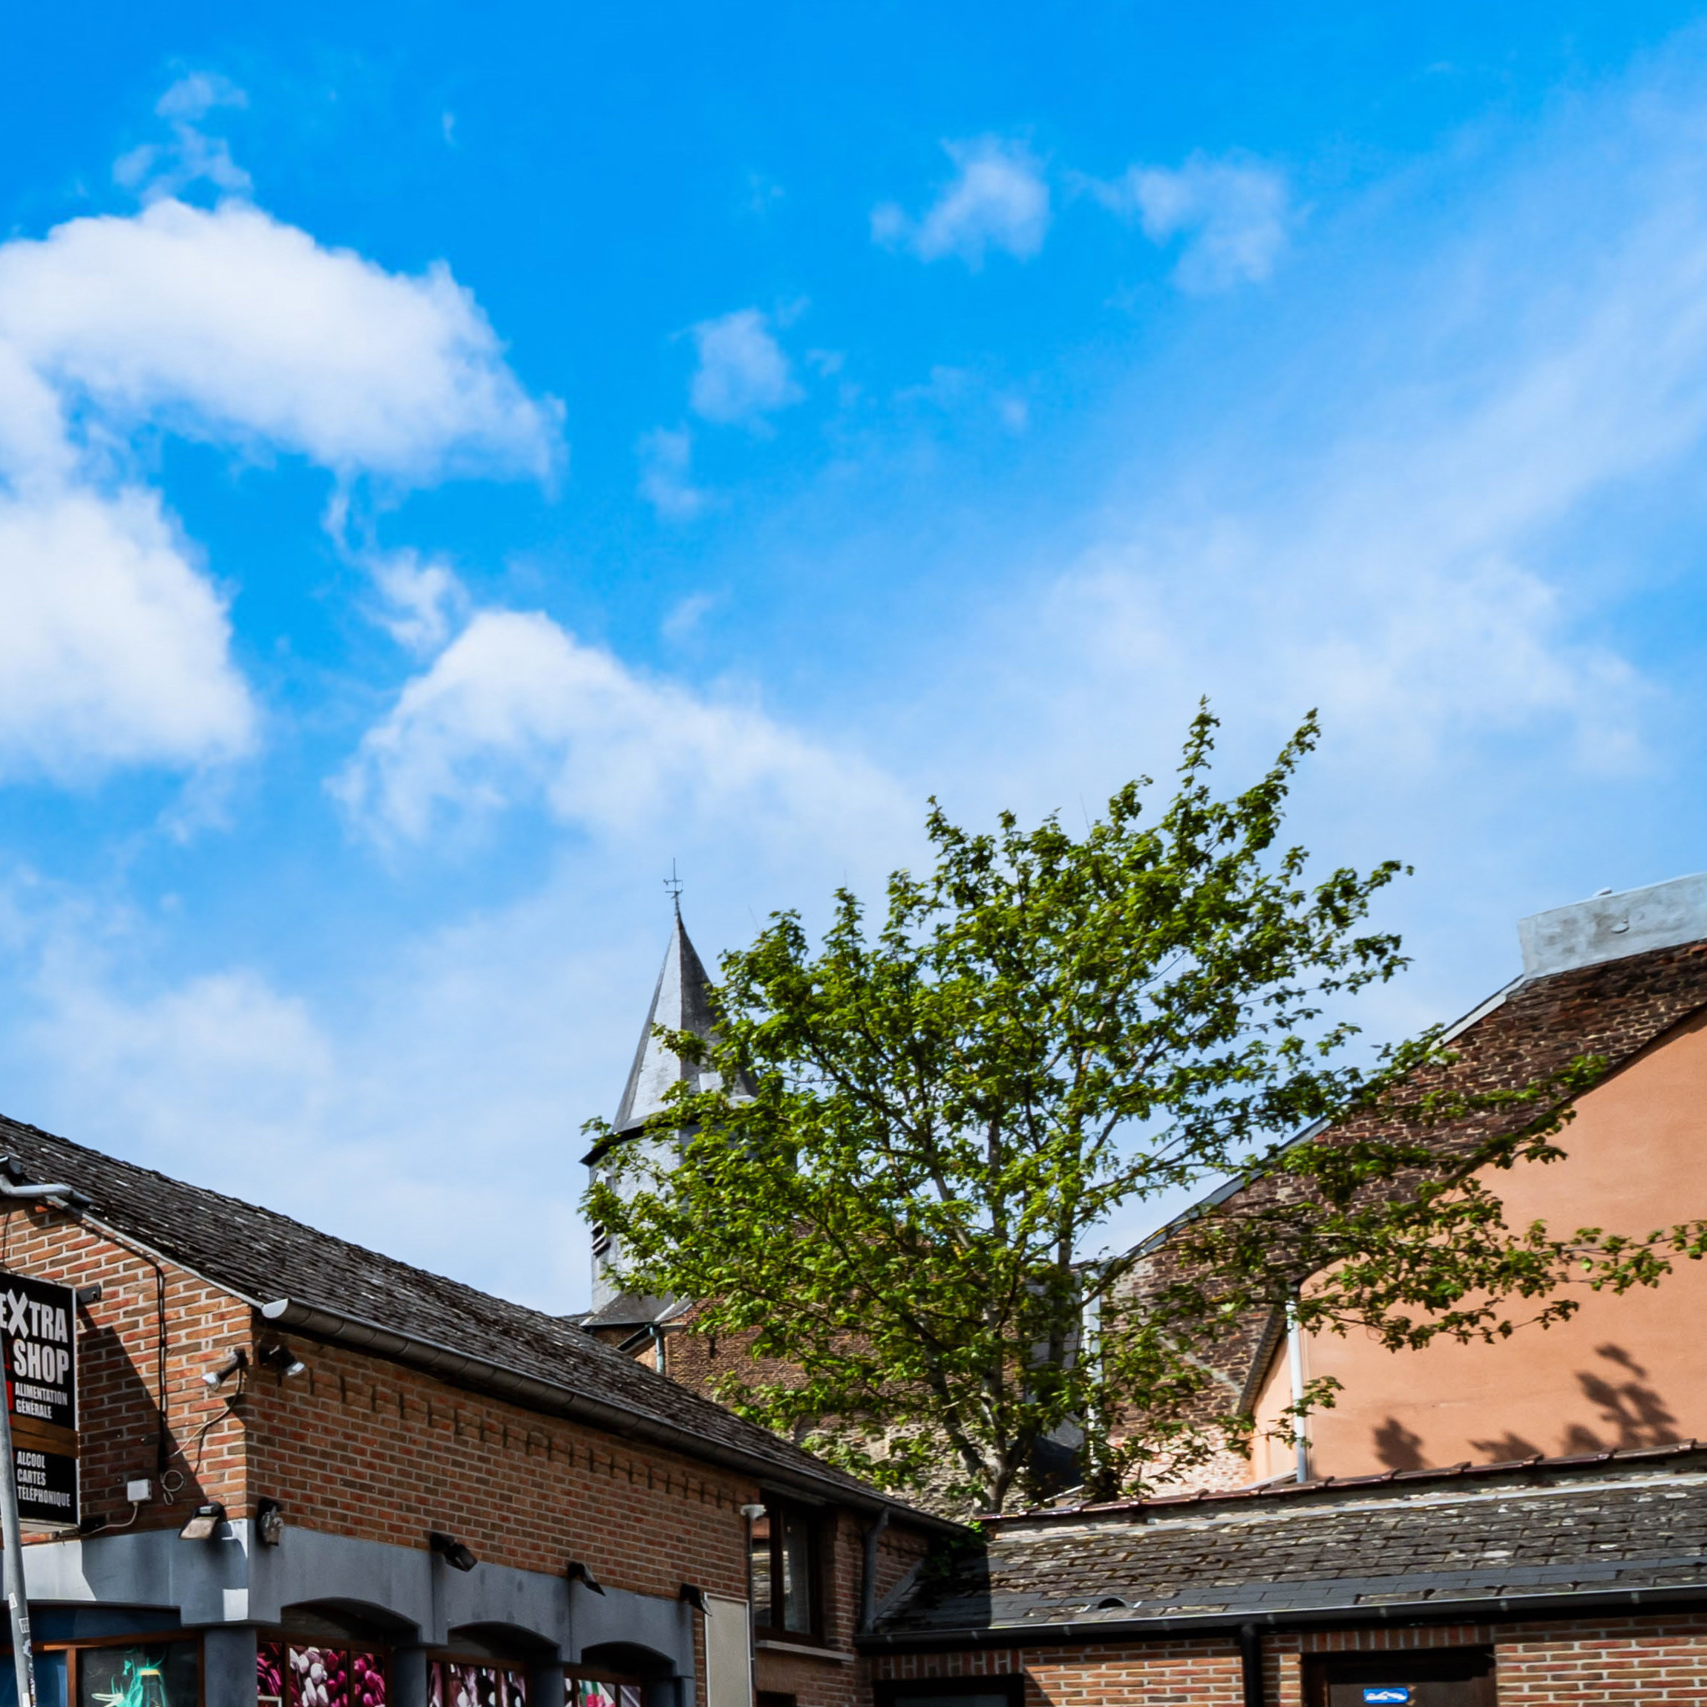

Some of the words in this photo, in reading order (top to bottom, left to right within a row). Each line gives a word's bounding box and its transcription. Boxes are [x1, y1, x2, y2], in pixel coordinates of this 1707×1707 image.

[13, 1339, 69, 1384] SHOP
[15, 1382, 68, 1406] ALIMENTATION
[16, 1398, 52, 1419] GÉNÉRALE
[16, 1451, 46, 1469] ALCOOL
[17, 1469, 46, 1486] CARTES
[17, 1485, 71, 1507] TÉLÉPHONIQUE
